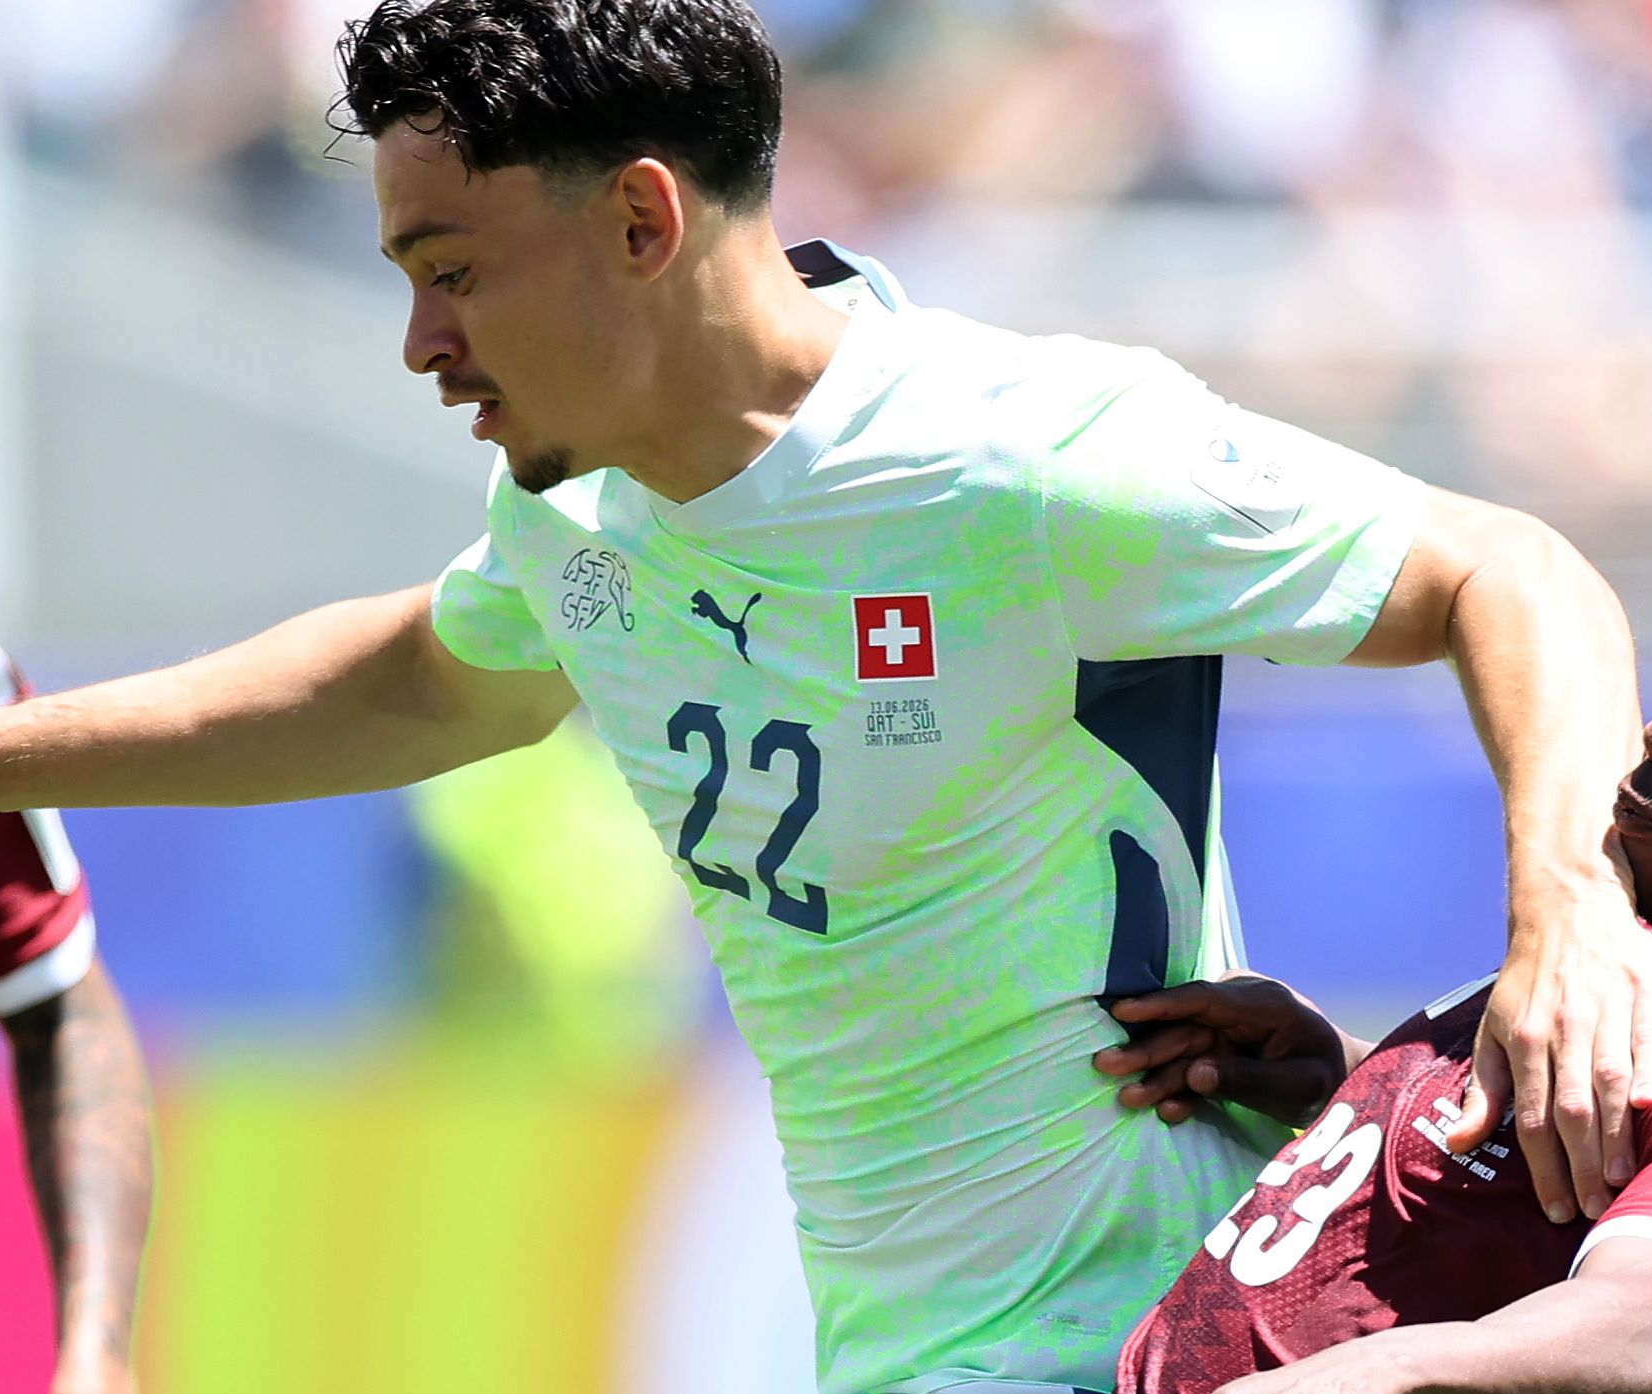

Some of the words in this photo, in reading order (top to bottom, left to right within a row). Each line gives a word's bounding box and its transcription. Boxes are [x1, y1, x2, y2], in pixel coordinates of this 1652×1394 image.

[870, 698, 930, 714] 13.06.2026
[867, 713, 894, 733] QAT
[910, 711, 936, 730] SUI
[865, 733, 883, 747] SAN
[886, 730, 942, 746] FRANCISCO
[667, 701, 829, 936] 22
[1469, 1161, 1497, 1181] AREA
[1204, 1102, 1382, 1287] 23
